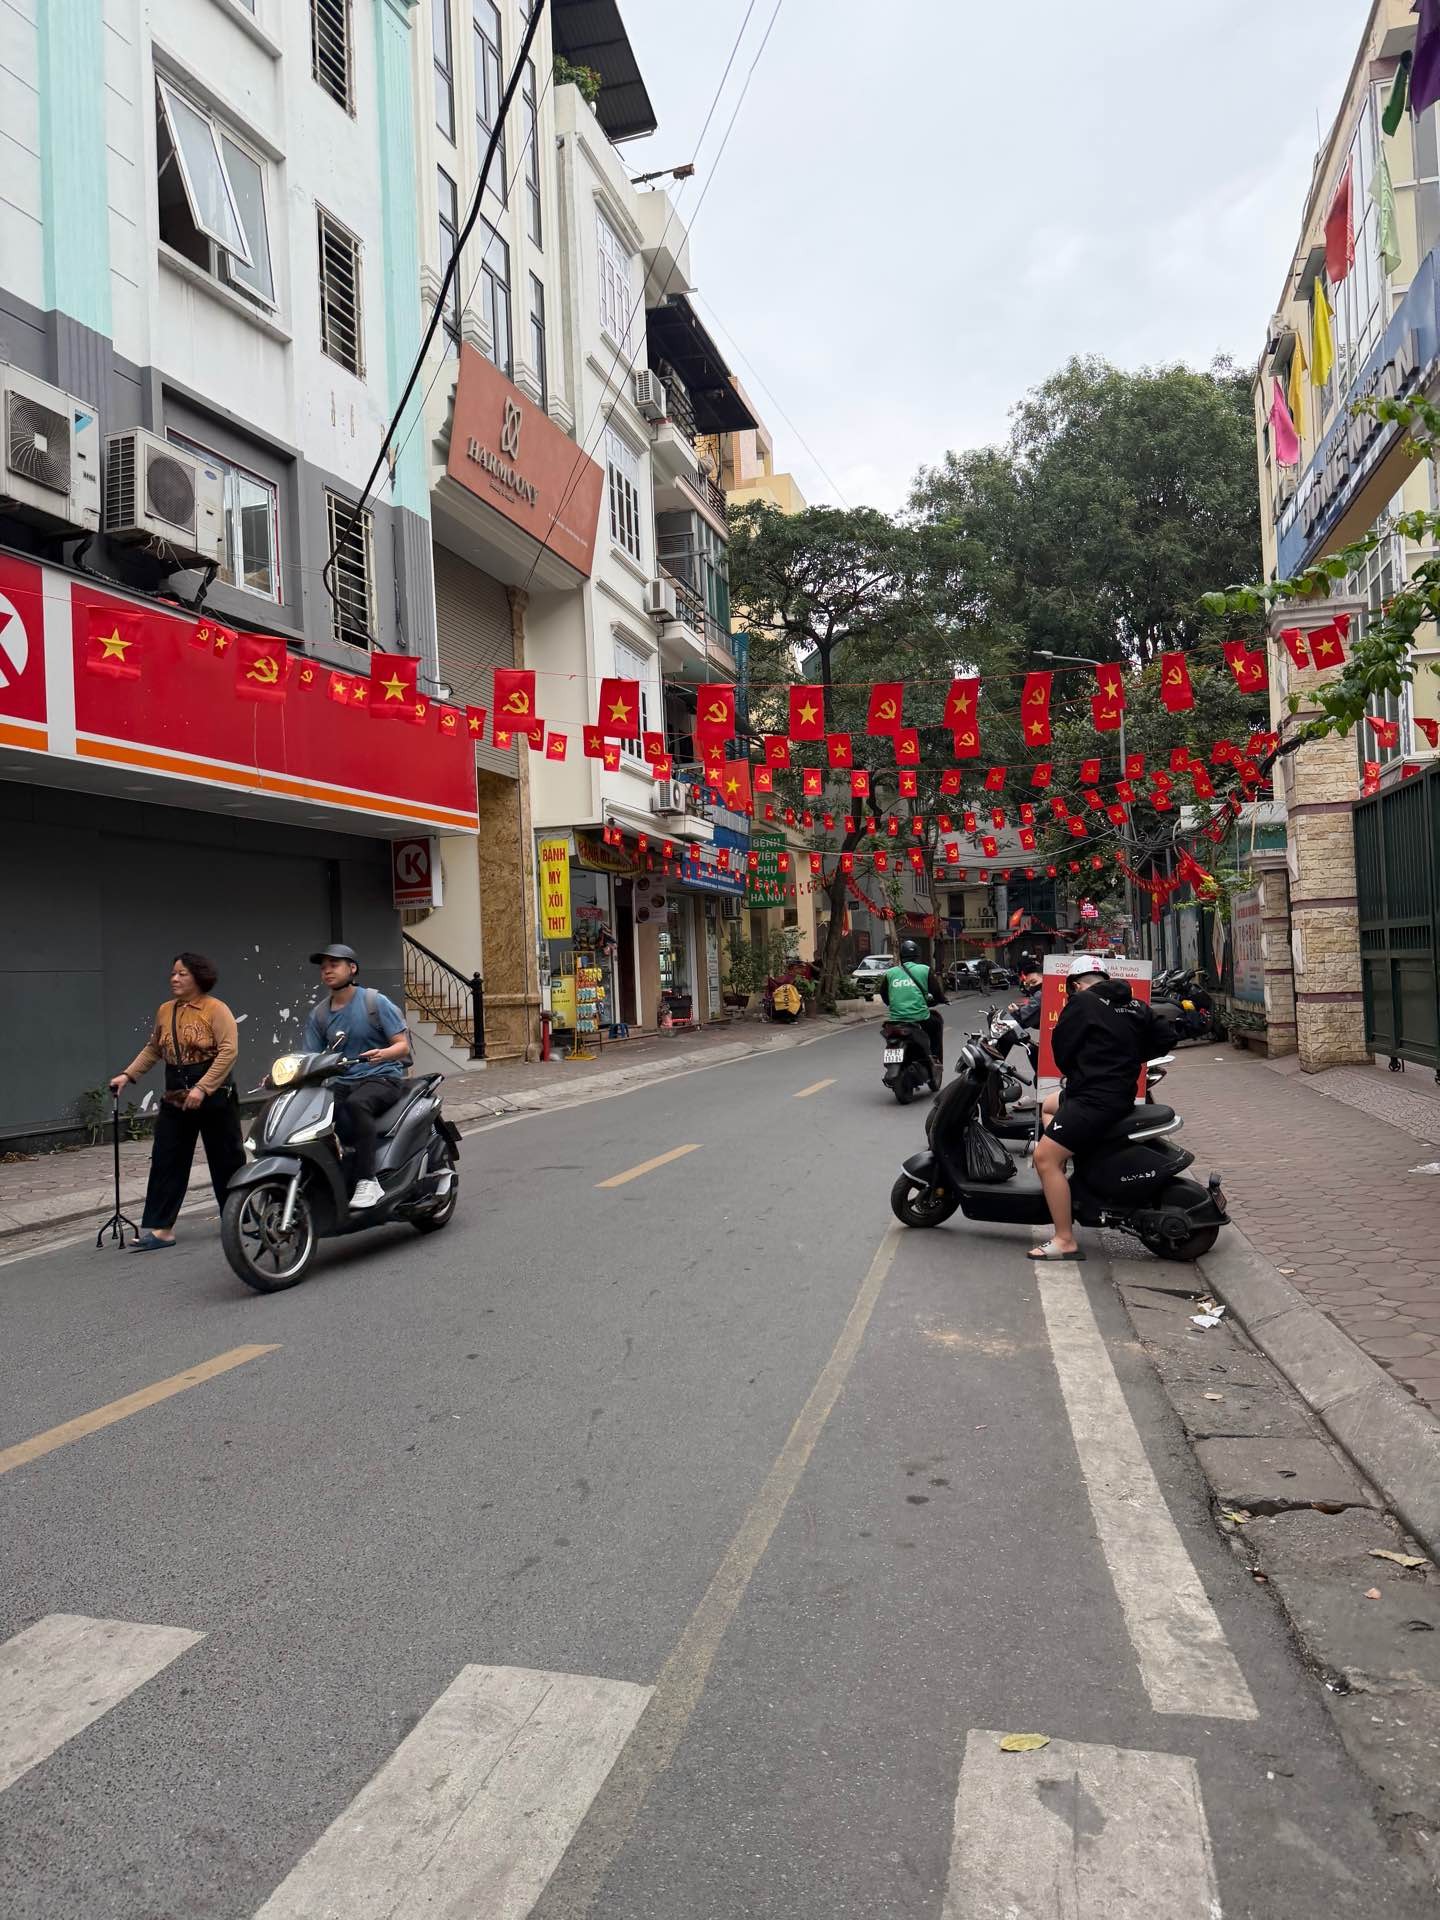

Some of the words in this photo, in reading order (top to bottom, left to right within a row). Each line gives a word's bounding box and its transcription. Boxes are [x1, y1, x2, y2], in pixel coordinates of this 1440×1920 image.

[542, 846, 566, 862] BÁNH
[405, 852, 425, 878] K
[548, 891, 563, 908] XÔI
[547, 916, 566, 933] THỊT
